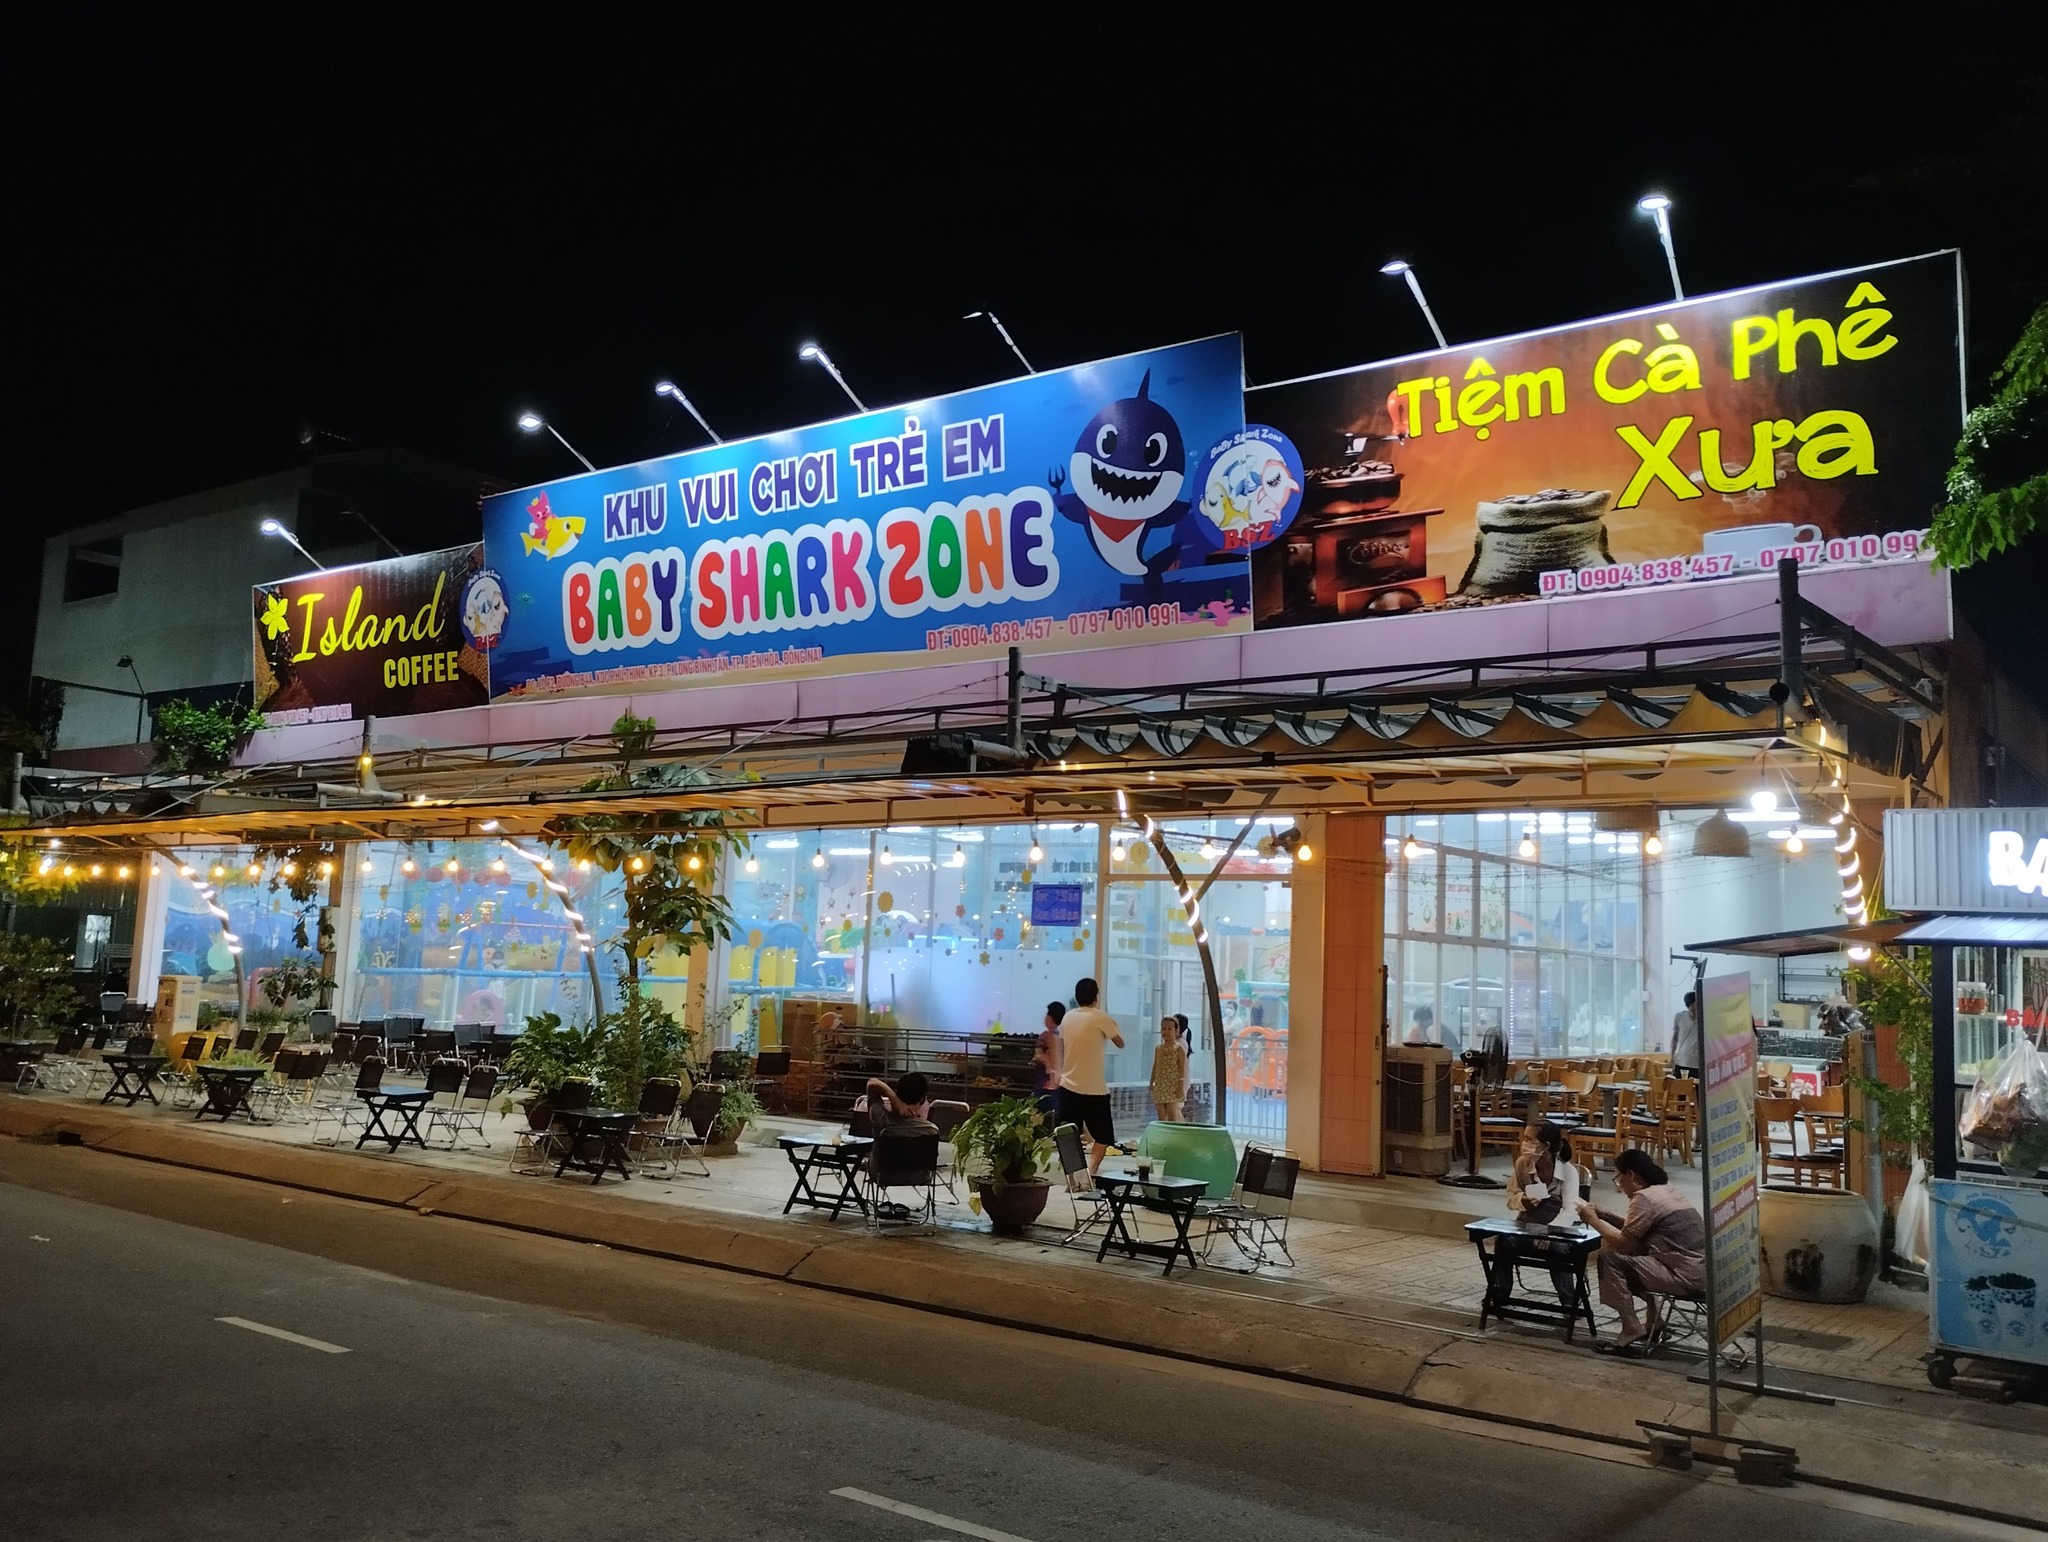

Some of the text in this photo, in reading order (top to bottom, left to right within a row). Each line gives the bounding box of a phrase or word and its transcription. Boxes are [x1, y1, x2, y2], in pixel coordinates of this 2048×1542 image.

[1397, 282, 1898, 441] Tiệm Cà Phê
[605, 414, 1005, 541] KHU VUI CHƠI TRẺ EM
[1612, 410, 1879, 511] Xưa
[567, 499, 1050, 646] BABY SHARK ZONE
[1542, 572, 1573, 592] ĐT:
[1580, 554, 1734, 588] 0904.838.457
[1830, 538, 1877, 560] 010
[1887, 533, 1927, 555] 99
[291, 570, 446, 663] Island
[806, 647, 822, 664] NAI
[927, 630, 949, 650] ĐT:
[952, 617, 1052, 649] 0904.838.457
[1069, 610, 1109, 636] 0797
[1114, 606, 1145, 631] 010
[1149, 602, 1181, 628] 991
[384, 651, 459, 688] COFFEE
